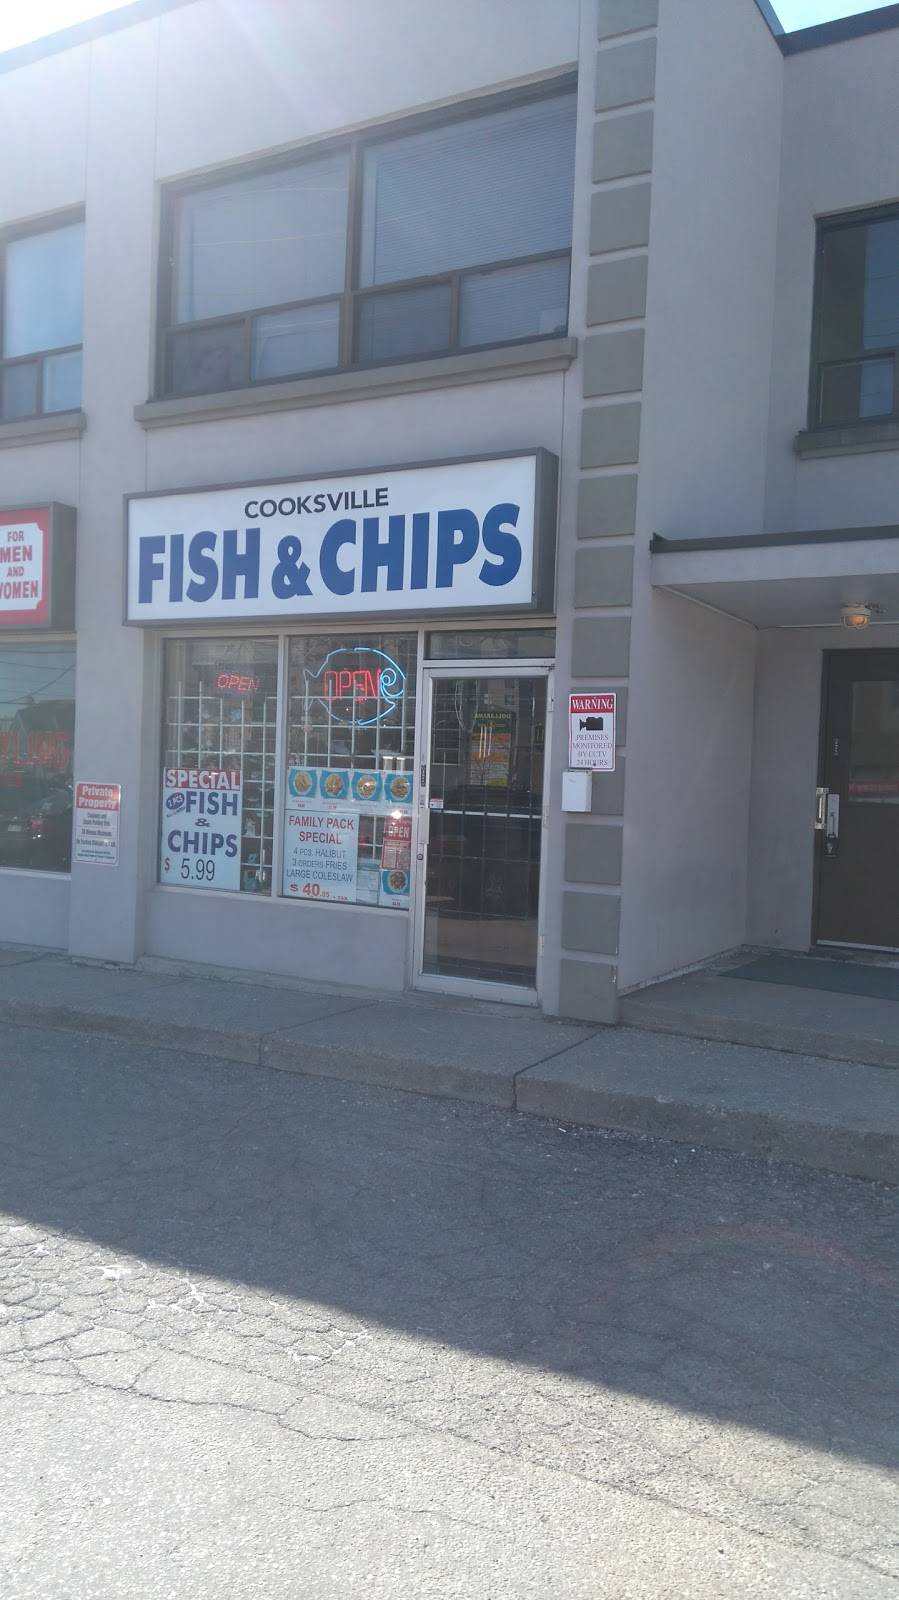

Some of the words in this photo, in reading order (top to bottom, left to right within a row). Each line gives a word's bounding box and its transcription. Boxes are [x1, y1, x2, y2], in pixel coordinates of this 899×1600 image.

[244, 487, 389, 519] COOKSVILLE
[7, 531, 24, 542] FOR
[0, 545, 33, 563] MEN
[138, 527, 261, 604] FISH
[271, 535, 313, 600] &
[319, 503, 522, 596] CHIPS
[7, 567, 24, 577] AND
[216, 672, 260, 692] OPEN
[323, 669, 382, 701] OPEN
[572, 698, 613, 710] WARNING
[166, 769, 240, 790] SPECIAL
[82, 785, 113, 797] Private
[79, 797, 116, 810] Property
[186, 791, 238, 816] FISH
[195, 818, 211, 827] &
[288, 815, 324, 828] FAMILY
[326, 818, 354, 830] PACK
[299, 831, 342, 844] SPECIAL
[388, 826, 409, 838] OPEN
[168, 830, 238, 857] CHIPS
[293, 847, 298, 855] 4
[315, 849, 347, 859] HALIBUT
[181, 858, 215, 881] 5.99
[298, 859, 324, 869] ORDERS
[325, 861, 348, 871] FRIES
[287, 868, 311, 879] LARGE
[312, 870, 353, 882] COLESLAW
